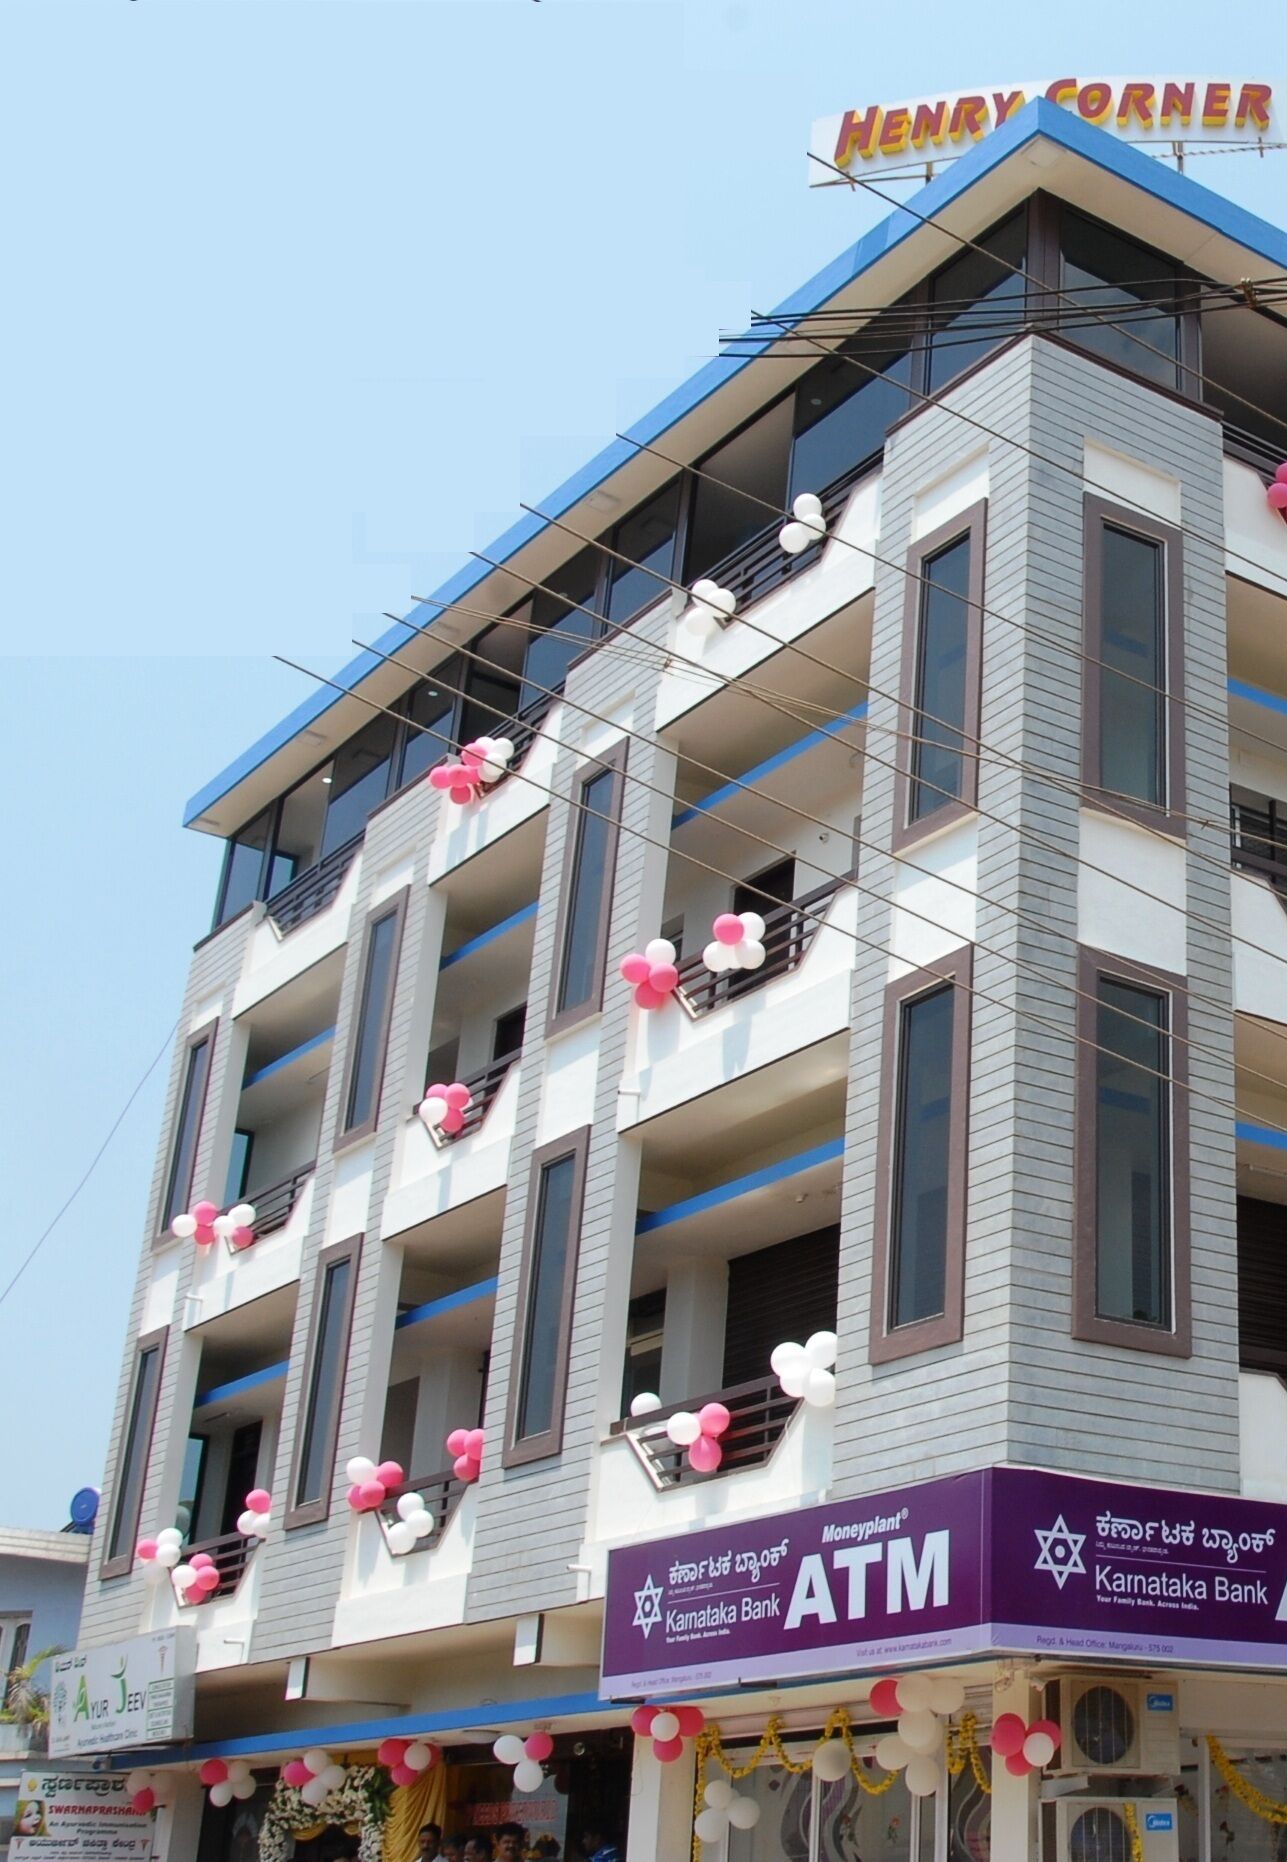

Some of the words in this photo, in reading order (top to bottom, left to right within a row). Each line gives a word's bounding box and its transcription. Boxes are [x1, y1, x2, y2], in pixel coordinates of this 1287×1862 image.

[834, 90, 1025, 168] HENRY
[1044, 78, 1273, 131] CORNER
[1202, 1526, 1275, 1564] ಬ್ಯಾಂಕ್
[783, 1529, 950, 1630] ATM
[1095, 1565, 1207, 1600] Karnataka
[1215, 1574, 1268, 1605] Bank
[665, 1601, 736, 1633] Karnataka
[741, 1593, 780, 1621] Bank
[1097, 1594, 1111, 1603] Your
[1113, 1596, 1135, 1607] Family
[1137, 1598, 1155, 1606] Bank.
[1157, 1600, 1179, 1608] Across
[1181, 1602, 1199, 1610] India.
[1066, 1638, 1084, 1647] Head
[1108, 1641, 1143, 1652] Mangaluru
[73, 1675, 109, 1722] AYUR
[111, 1654, 147, 1714] JEEV
[41, 1776, 128, 1798] ಸ್ವರ್ಣಪ್ರಾಶ
